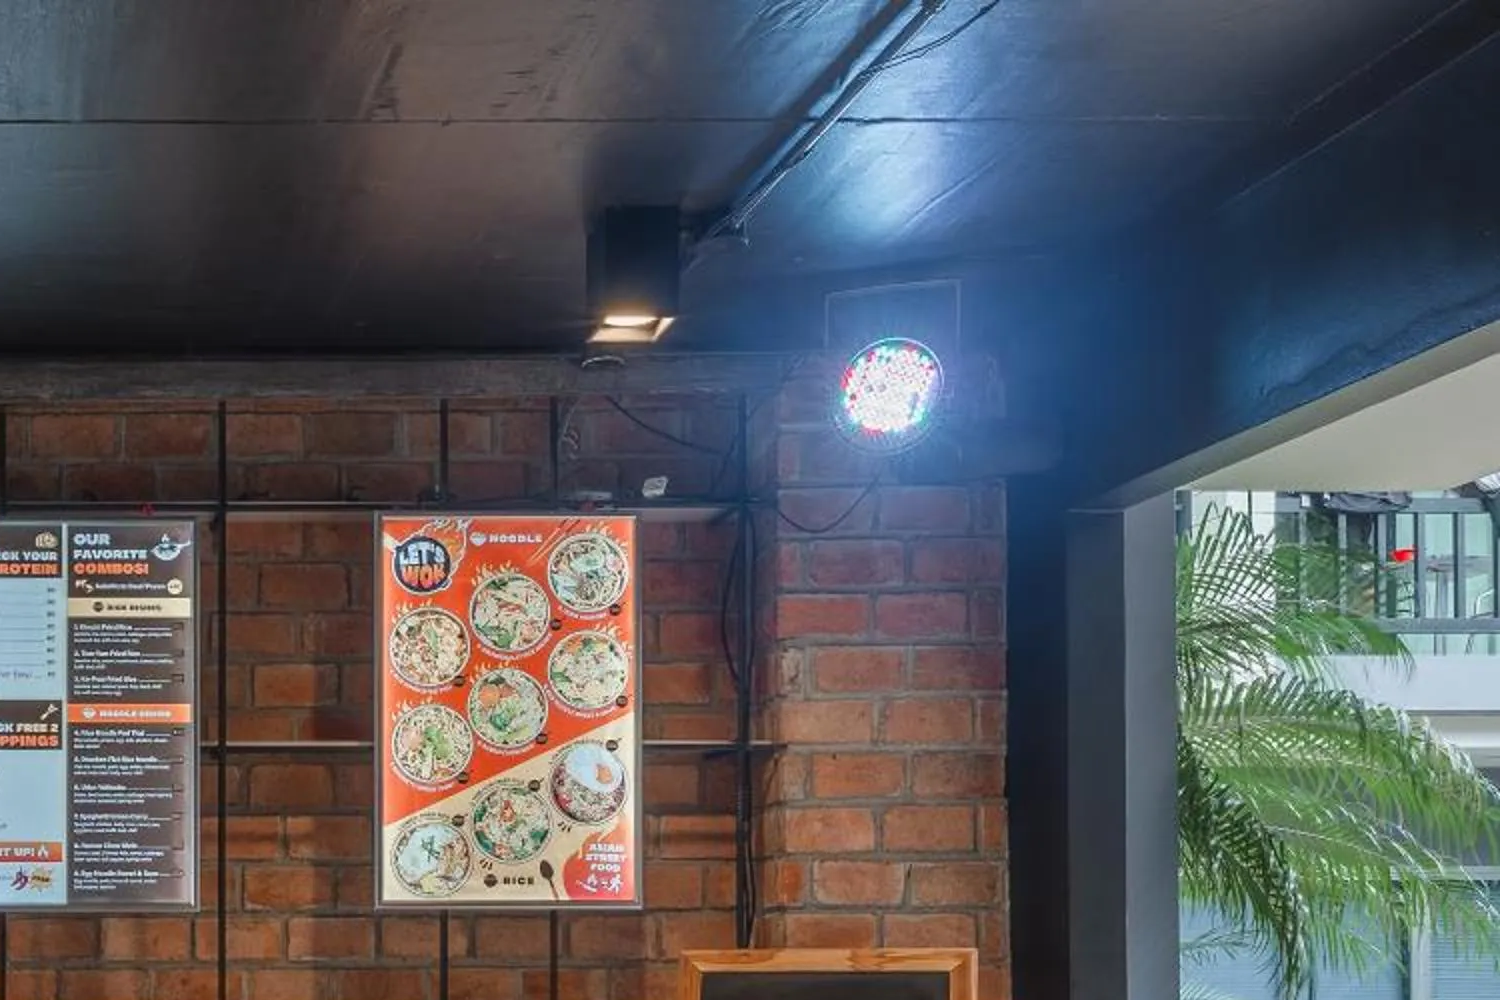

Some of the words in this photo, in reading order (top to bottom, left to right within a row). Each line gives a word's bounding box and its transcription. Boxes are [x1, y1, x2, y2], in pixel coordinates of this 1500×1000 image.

[73, 533, 111, 546] OUR
[489, 533, 543, 543] NOODLE
[23, 552, 57, 561] YOUR
[73, 549, 148, 560] FAVORITE
[399, 541, 446, 565] LET'S
[73, 563, 149, 575] COMBOS!
[401, 564, 445, 588] WOK
[17, 722, 46, 733] FREE
[49, 722, 59, 733] 2
[14, 847, 35, 857] UP!
[589, 843, 625, 853] ASIAN
[585, 853, 628, 862] STREET
[590, 863, 621, 873] FOOD
[503, 876, 535, 885] RICE
